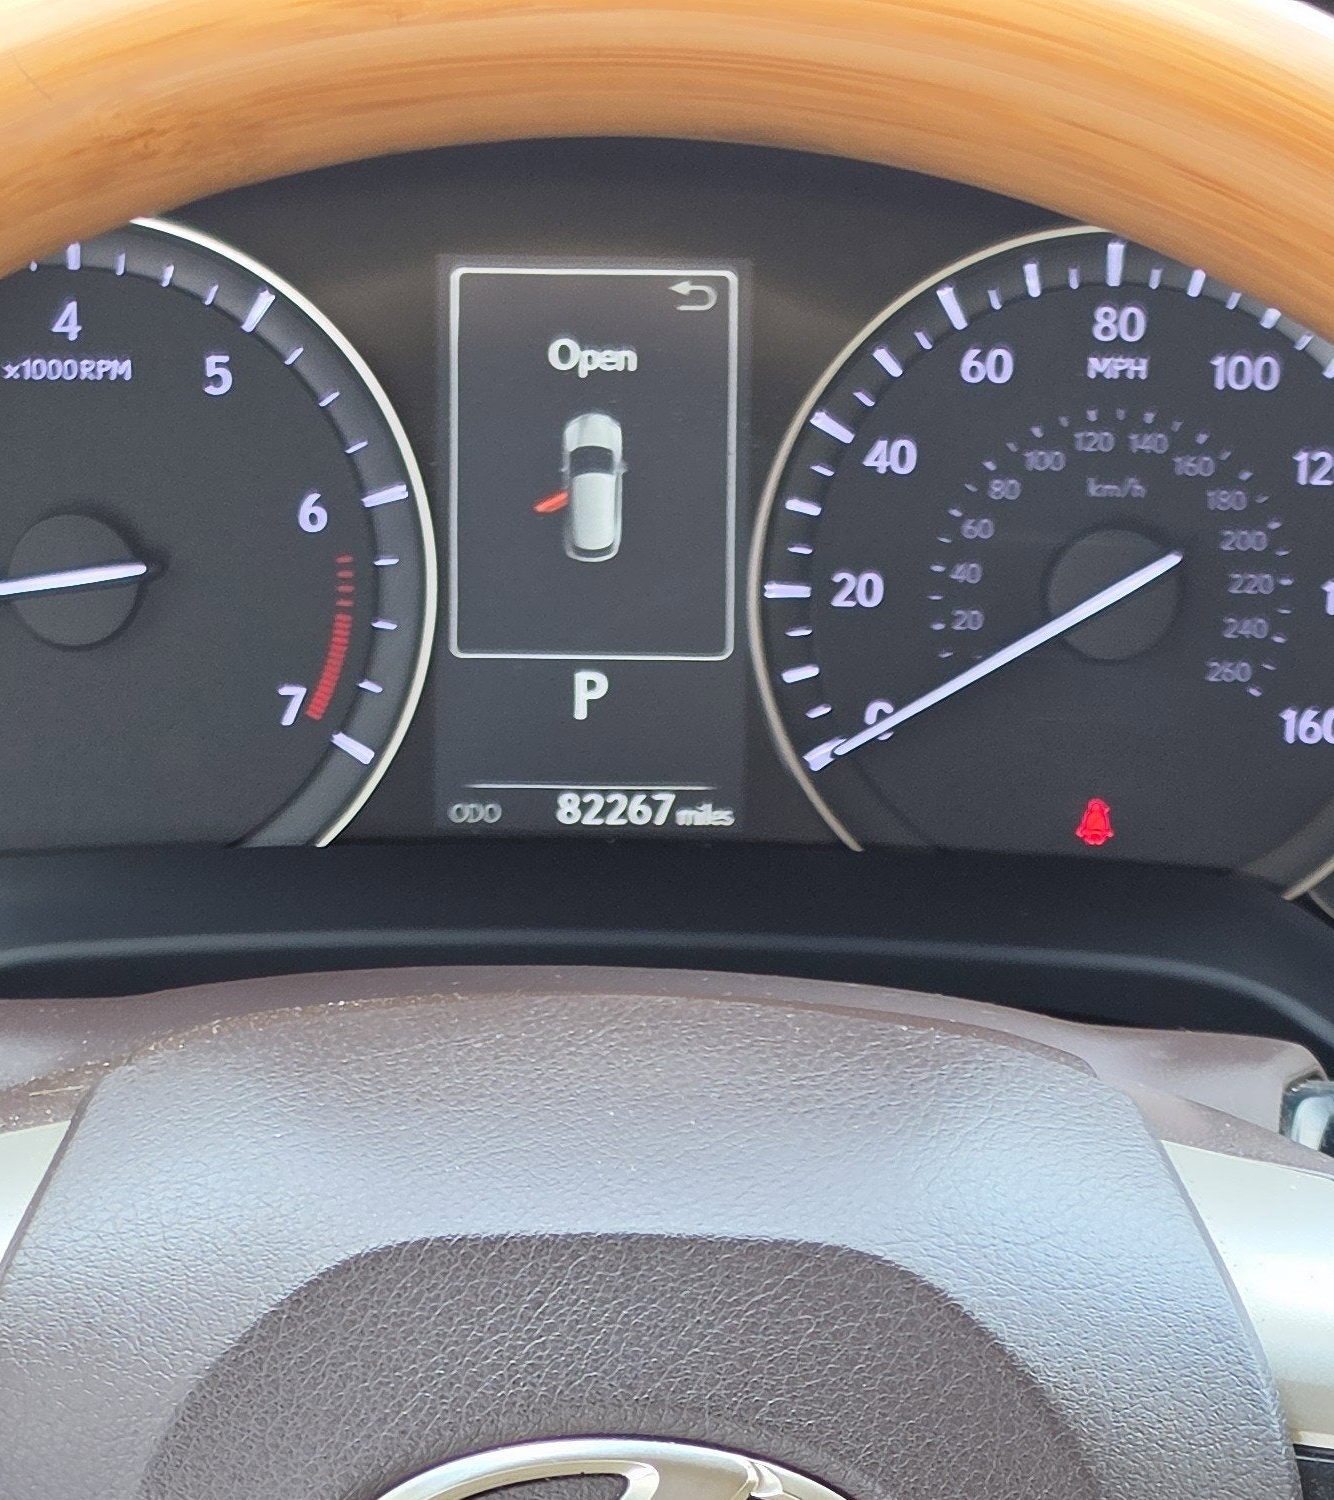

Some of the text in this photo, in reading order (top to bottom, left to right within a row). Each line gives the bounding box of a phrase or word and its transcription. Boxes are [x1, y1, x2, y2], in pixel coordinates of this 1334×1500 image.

[51, 300, 82, 341] 4
[1092, 305, 1146, 343] 80
[548, 338, 638, 379] Open
[960, 350, 1014, 384] 60
[1087, 356, 1148, 381] MPH
[204, 355, 233, 396] 5
[1212, 354, 1281, 391] 100
[1074, 431, 1116, 452] 120
[1127, 432, 1168, 454] 140
[863, 439, 917, 475] 40
[1024, 450, 1066, 471] 100
[1173, 455, 1215, 477] 160
[988, 478, 1021, 500] 80
[298, 492, 327, 533] 6
[961, 518, 995, 540] 60
[1220, 529, 1268, 551] 200
[950, 562, 983, 584] 40
[1228, 573, 1275, 595] 220
[831, 572, 884, 608] 20
[951, 609, 984, 632] 20
[1223, 617, 1269, 639] 240
[277, 684, 307, 726] 7
[573, 670, 609, 721] P
[447, 803, 503, 824] ODO
[556, 793, 736, 827] 82267 miles
